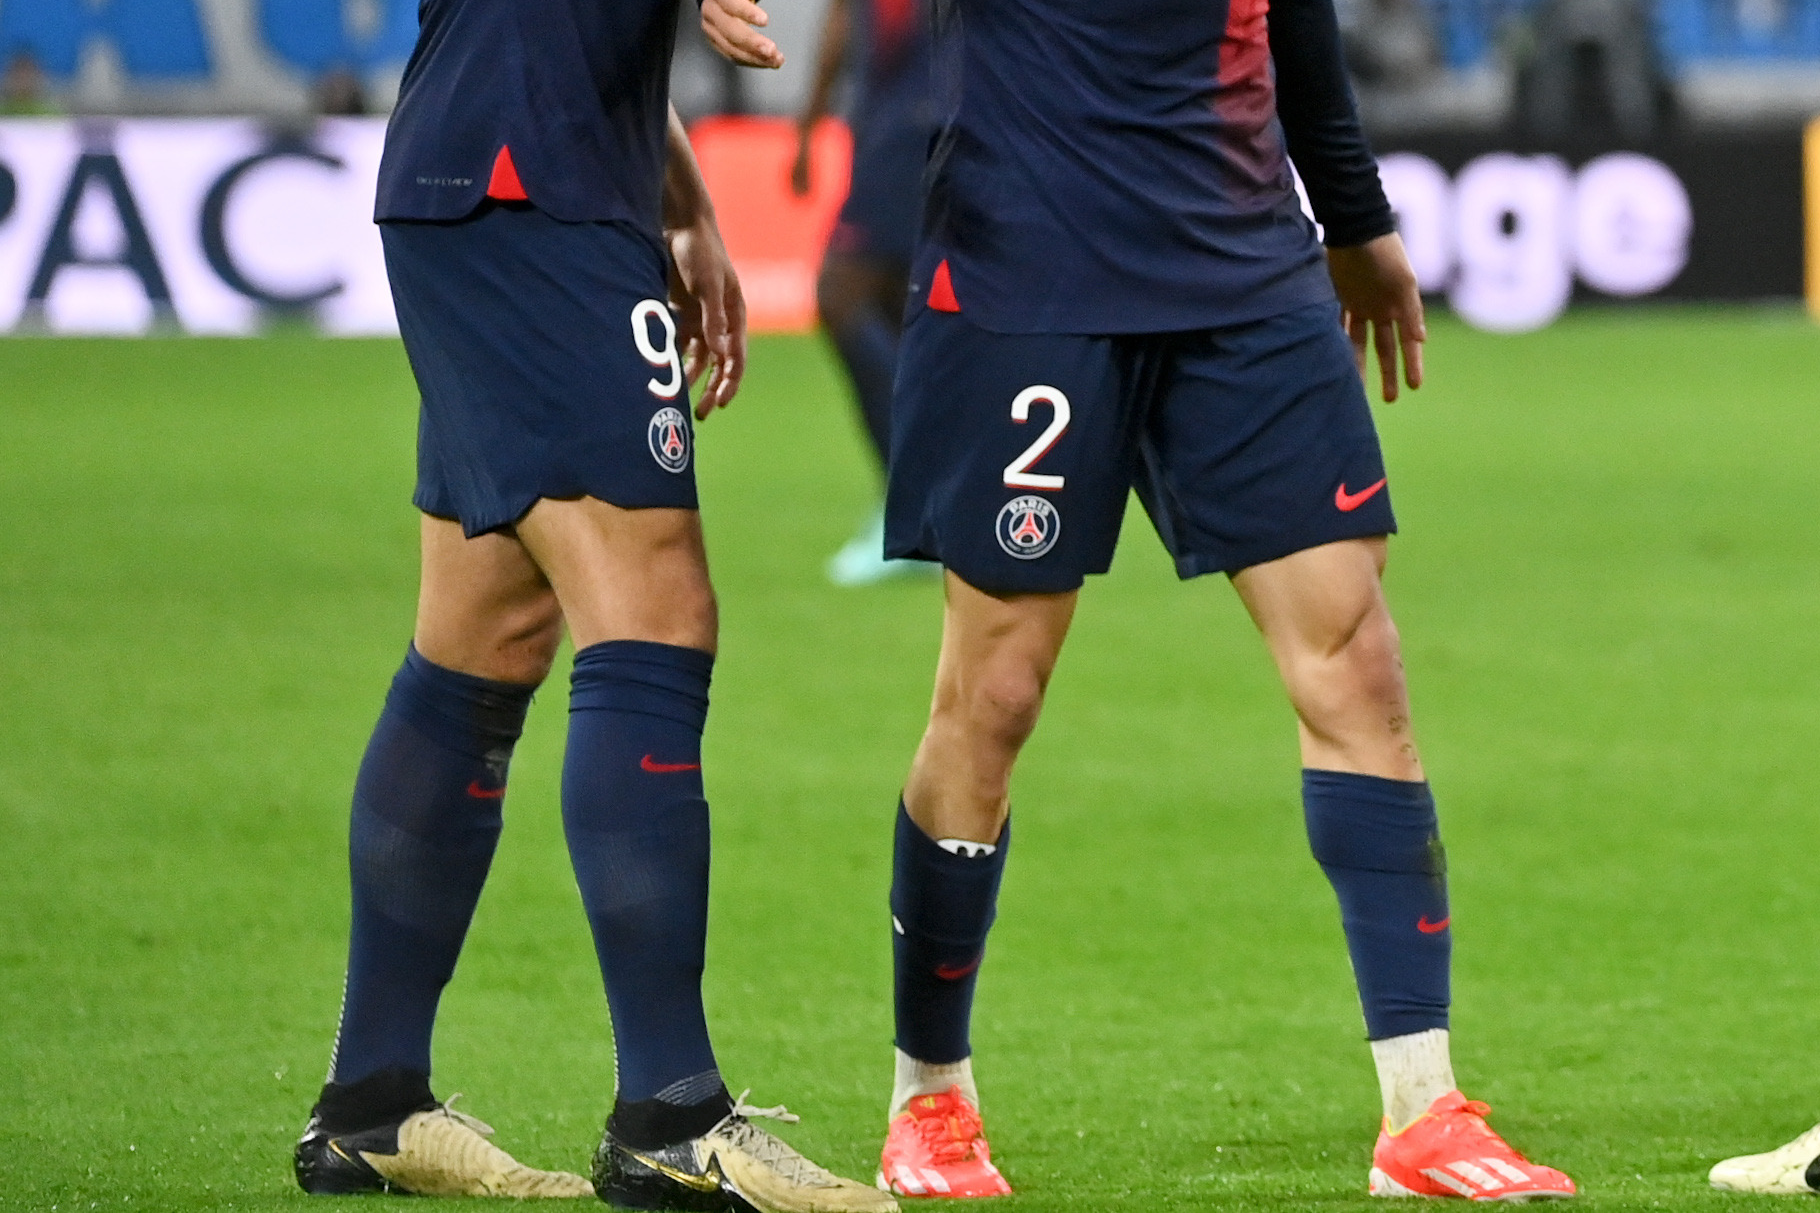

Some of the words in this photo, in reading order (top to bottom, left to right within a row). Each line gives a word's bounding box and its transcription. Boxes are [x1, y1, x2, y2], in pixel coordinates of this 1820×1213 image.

[631, 299, 682, 400] 9
[1003, 385, 1071, 492] 2
[1009, 498, 1051, 517] PARIS
